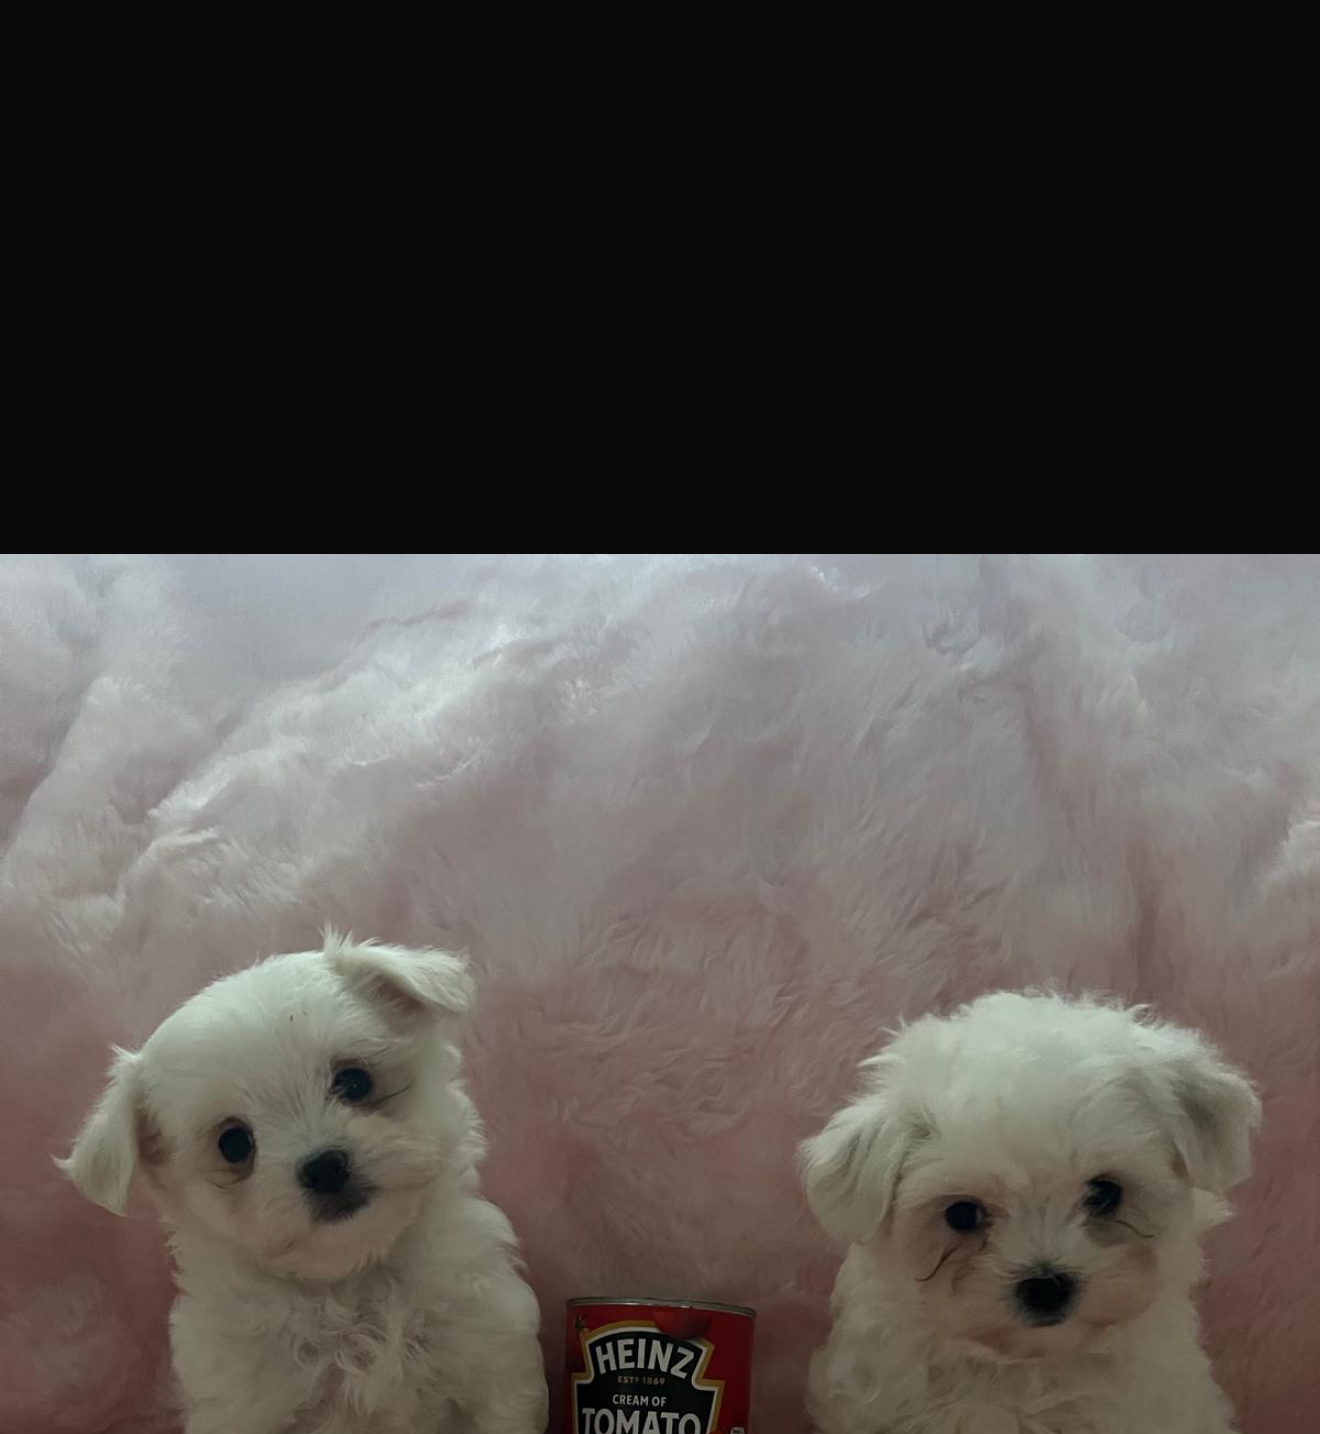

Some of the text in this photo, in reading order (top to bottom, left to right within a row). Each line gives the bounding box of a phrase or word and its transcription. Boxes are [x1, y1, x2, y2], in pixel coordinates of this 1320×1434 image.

[595, 1338, 694, 1379] HEINZ
[642, 1376, 666, 1386] 1869
[612, 1394, 667, 1407] CREAM OF
